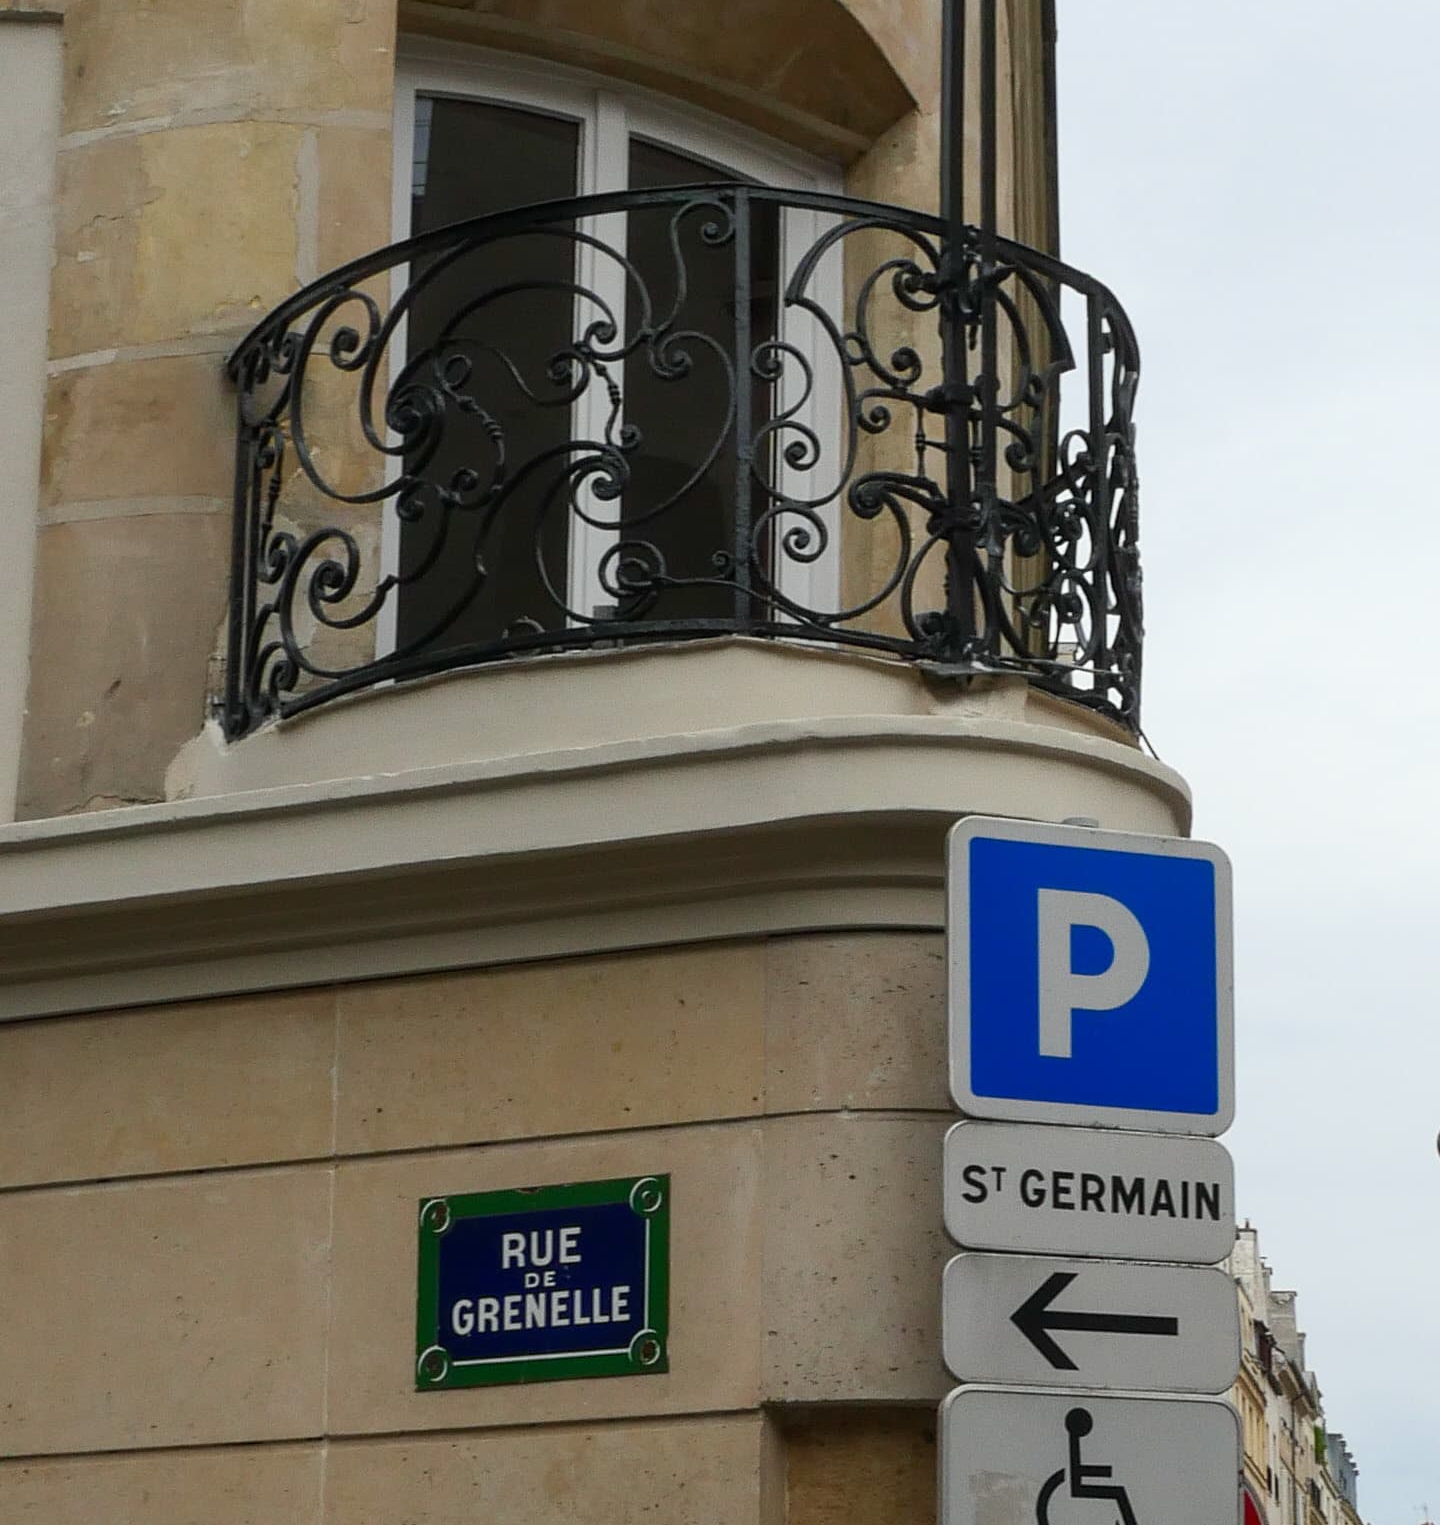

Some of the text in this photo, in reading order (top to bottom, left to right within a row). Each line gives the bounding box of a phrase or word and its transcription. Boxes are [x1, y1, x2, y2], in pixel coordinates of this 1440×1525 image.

[1037, 887, 1150, 1059] P
[1019, 1168, 1221, 1222] GERMAIN
[501, 1226, 582, 1270] RUE
[524, 1270, 557, 1289] DE
[451, 1284, 631, 1336] GRENELLE
